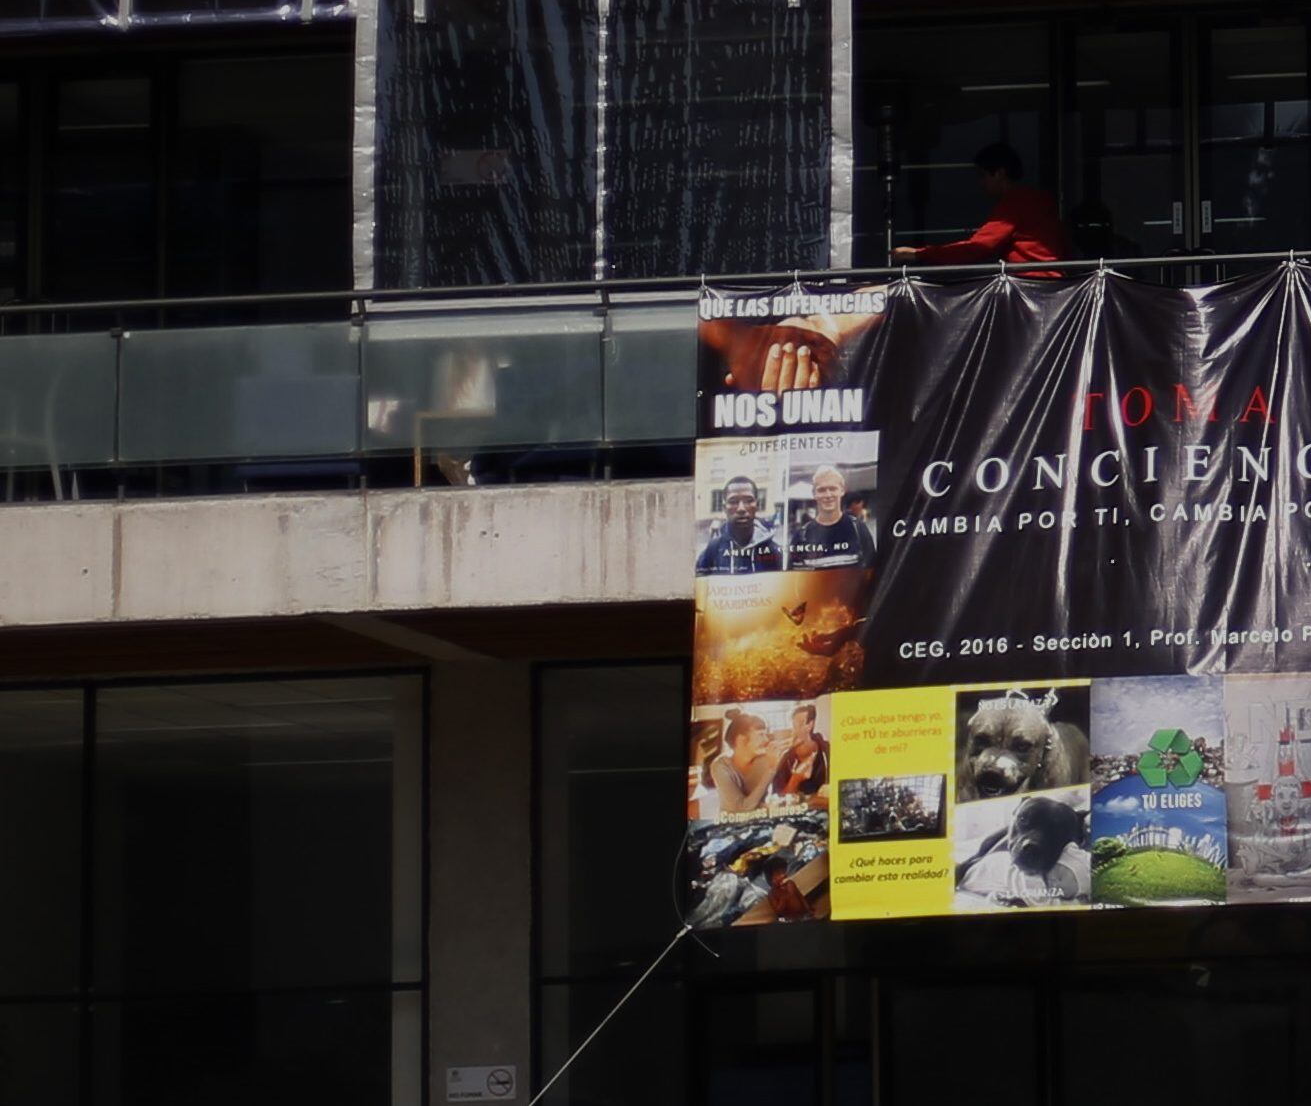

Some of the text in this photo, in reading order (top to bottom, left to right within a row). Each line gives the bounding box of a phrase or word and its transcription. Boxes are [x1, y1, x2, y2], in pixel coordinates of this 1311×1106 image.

[700, 293, 885, 320] QUE LAS DIFERENCIAS
[714, 388, 863, 428] NOS UNAN
[1074, 382, 1276, 431] TOMA
[739, 436, 843, 456] ¿DIFERENTES?
[893, 514, 1003, 537] CAMBIA
[1018, 511, 1077, 530] POR
[1094, 507, 1130, 526] TI,
[1150, 502, 1267, 522] CAMBIA
[778, 542, 828, 554] CENCIA,
[833, 541, 849, 551] NO
[899, 640, 951, 659] CEG,
[960, 637, 1008, 655] 2016
[1123, 630, 1141, 649] 1,
[1150, 628, 1200, 646] Prof.
[1211, 627, 1293, 645] Marcelo
[1160, 792, 1202, 809] ELIGES
[909, 854, 934, 866] para
[834, 873, 875, 885] cambiar
[901, 868, 950, 881] realidad?
